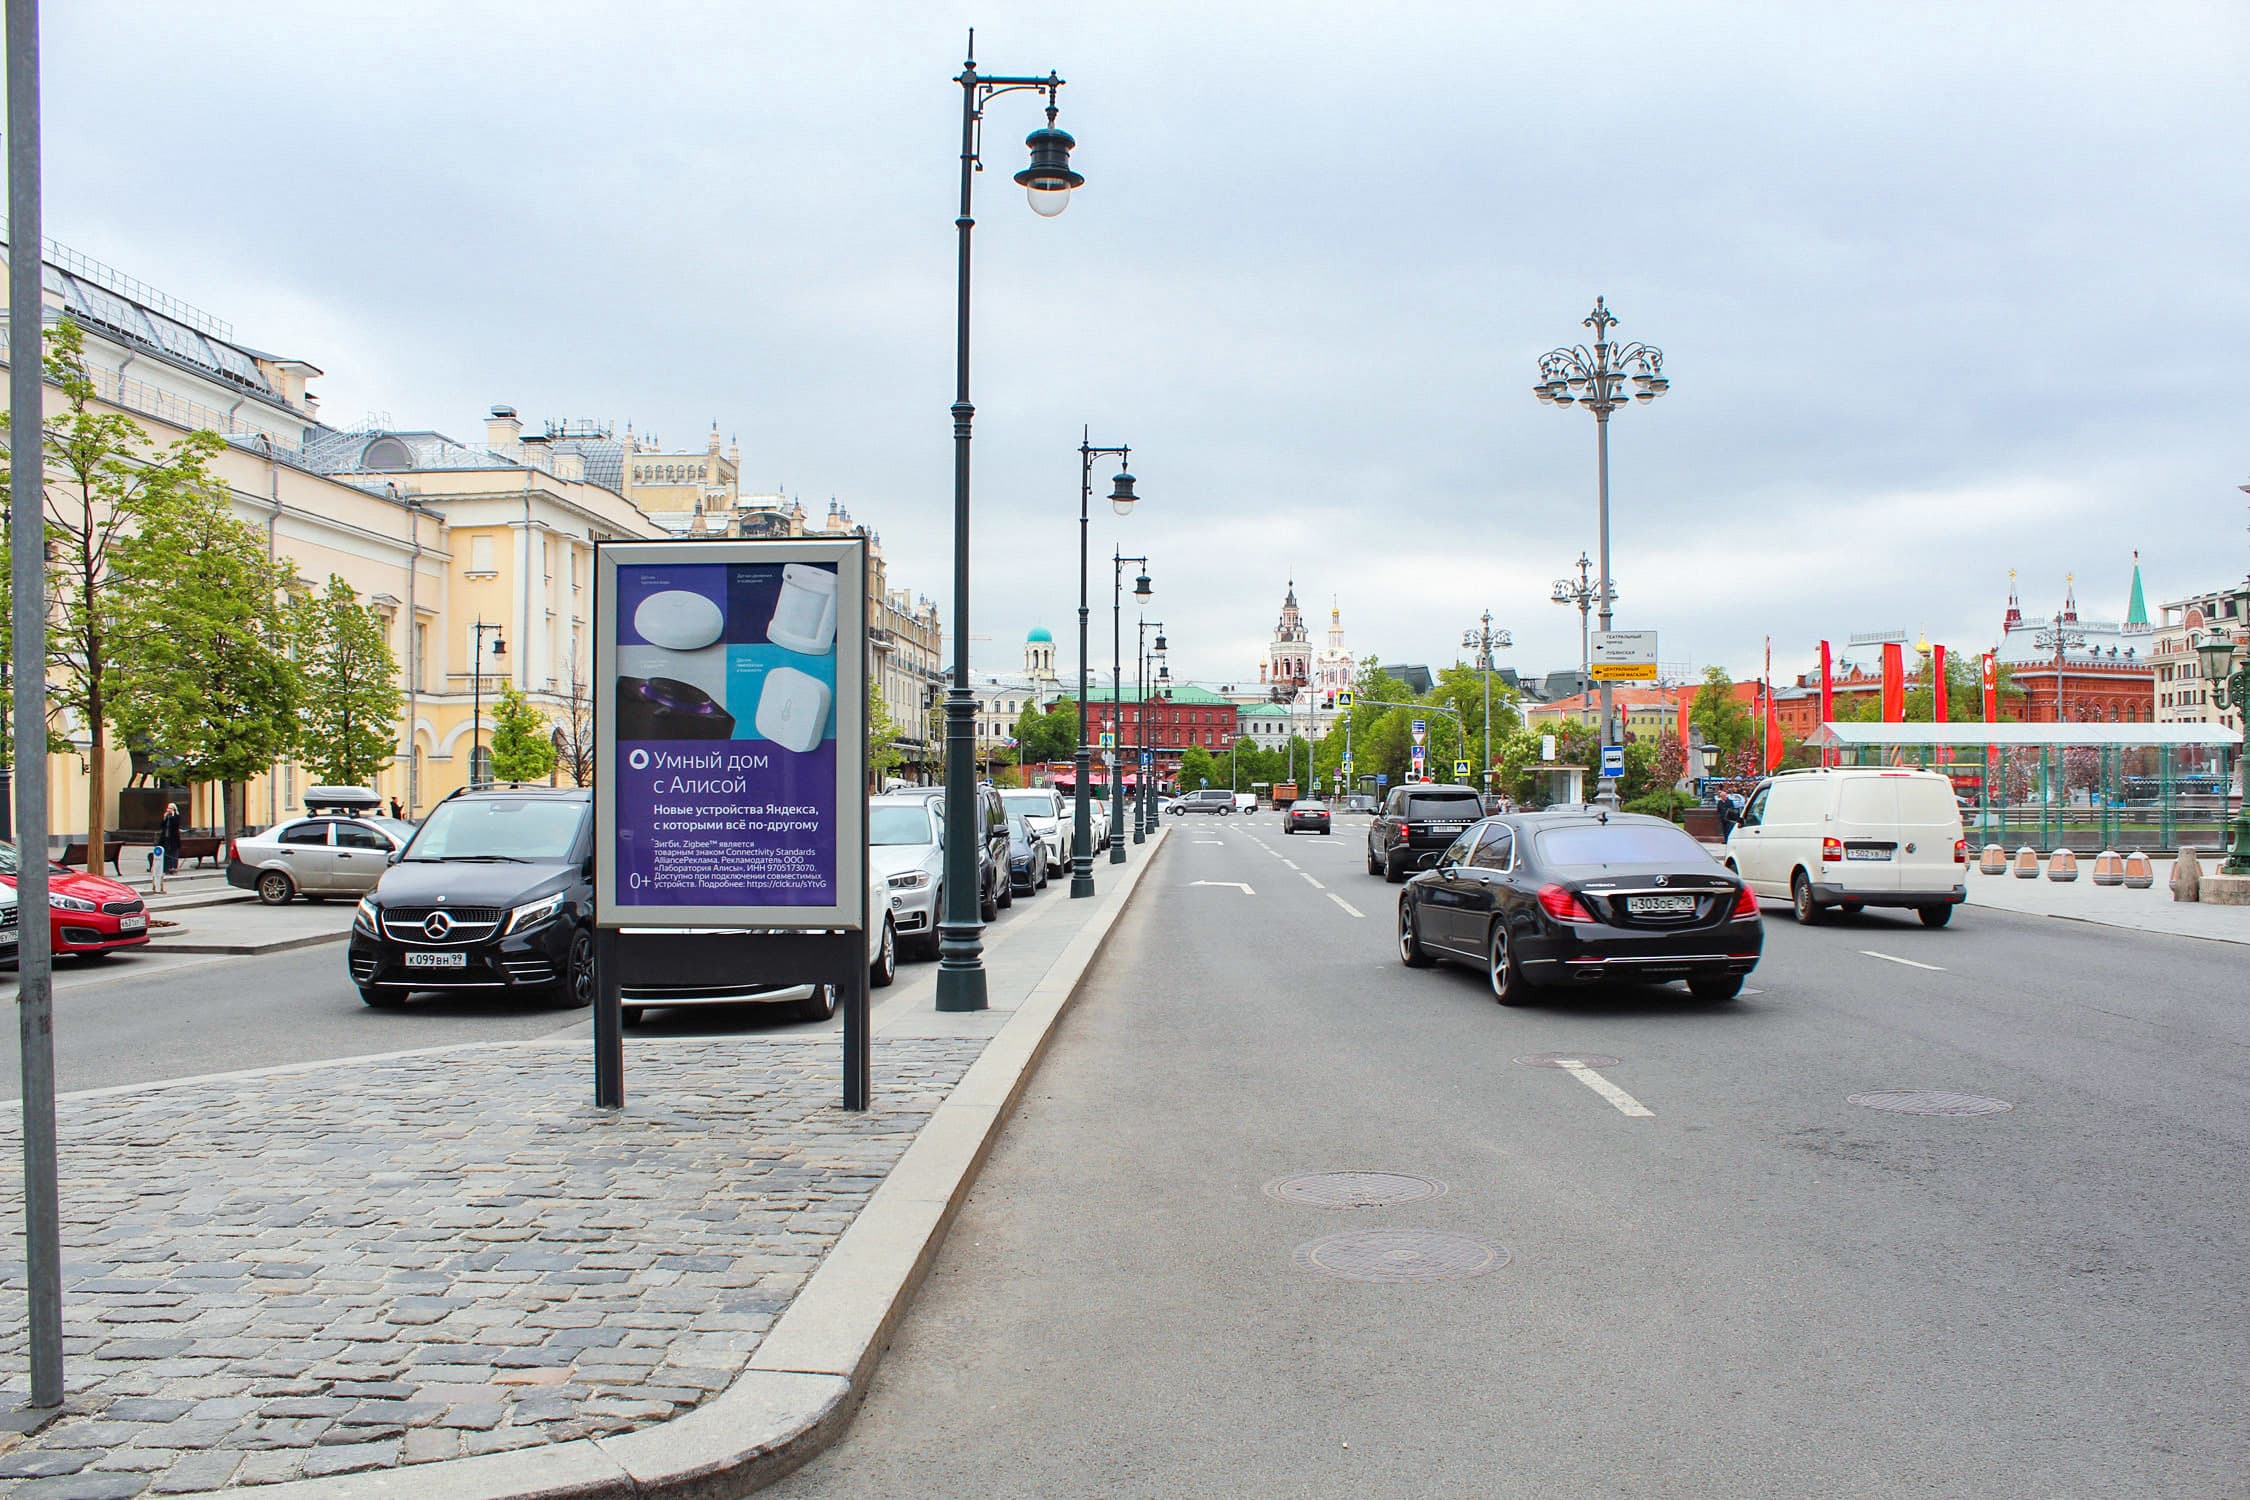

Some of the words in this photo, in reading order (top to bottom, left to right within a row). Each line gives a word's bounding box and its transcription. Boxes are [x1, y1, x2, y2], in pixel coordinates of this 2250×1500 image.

[654, 751, 722, 769] Умный
[727, 755, 768, 772] дом
[653, 780, 665, 793] с
[669, 775, 746, 793] Алисой
[653, 804, 693, 815] Новые
[695, 803, 763, 817] устройства
[766, 804, 819, 816] Яндекса,
[653, 822, 661, 830] с
[663, 822, 723, 833] которыми
[726, 819, 746, 830] всё
[748, 821, 819, 832] по-другому
[654, 848, 694, 857] товарным
[725, 848, 775, 857] Connectivity
[775, 848, 816, 856] Standards
[721, 856, 783, 865] Рекламодатель
[654, 864, 712, 873] «Лаборатория
[747, 864, 766, 872] ИНН
[767, 864, 817, 872] 9705173070.
[630, 872, 652, 889] 0+
[654, 873, 693, 881] Доступно
[654, 880, 697, 889] устройств.
[698, 880, 746, 889] Подробнее:
